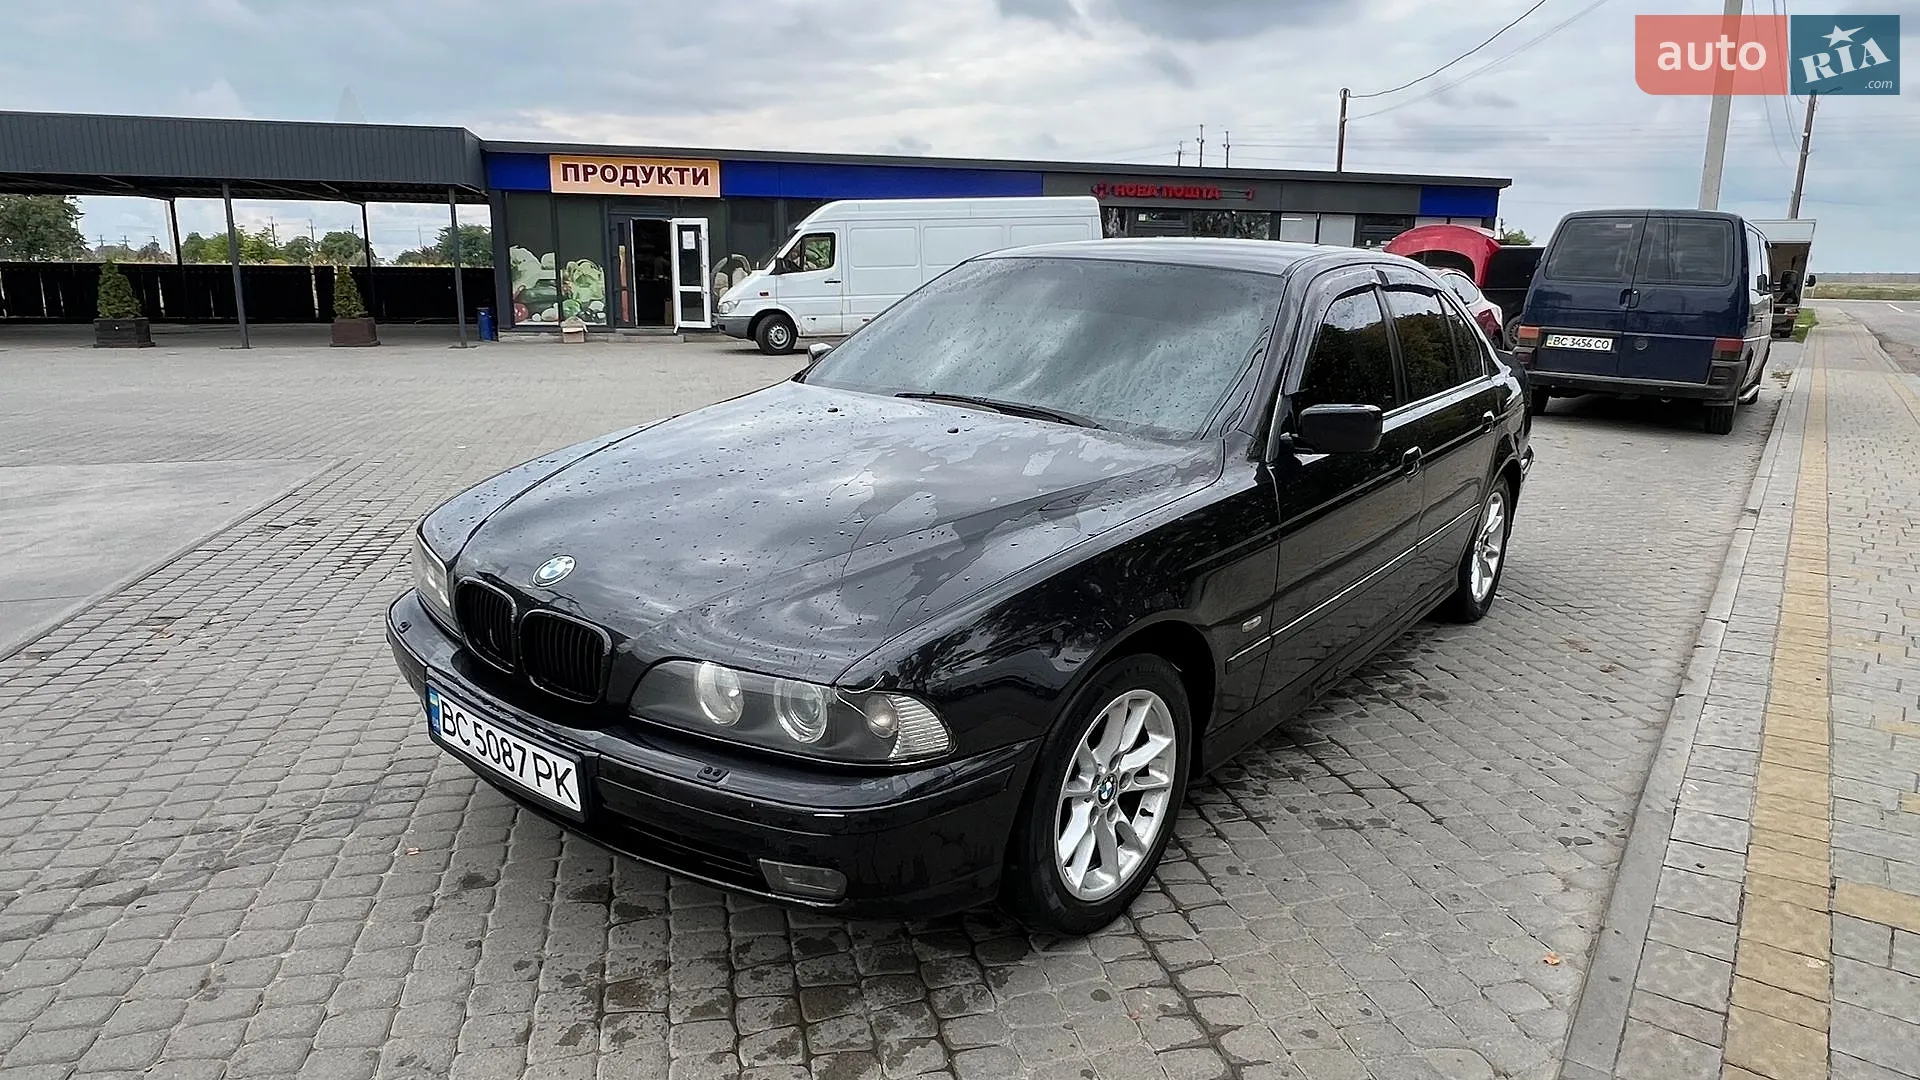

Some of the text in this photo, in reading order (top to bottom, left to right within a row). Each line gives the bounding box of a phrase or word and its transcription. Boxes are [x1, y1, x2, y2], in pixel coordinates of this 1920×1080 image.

[560, 162, 710, 188] ПРОДУКТИ
[1114, 182, 1222, 200] НОВА ПОШТА
[1553, 336, 1609, 349] BC 3456 CO
[441, 699, 577, 805] BC 5087 PK
